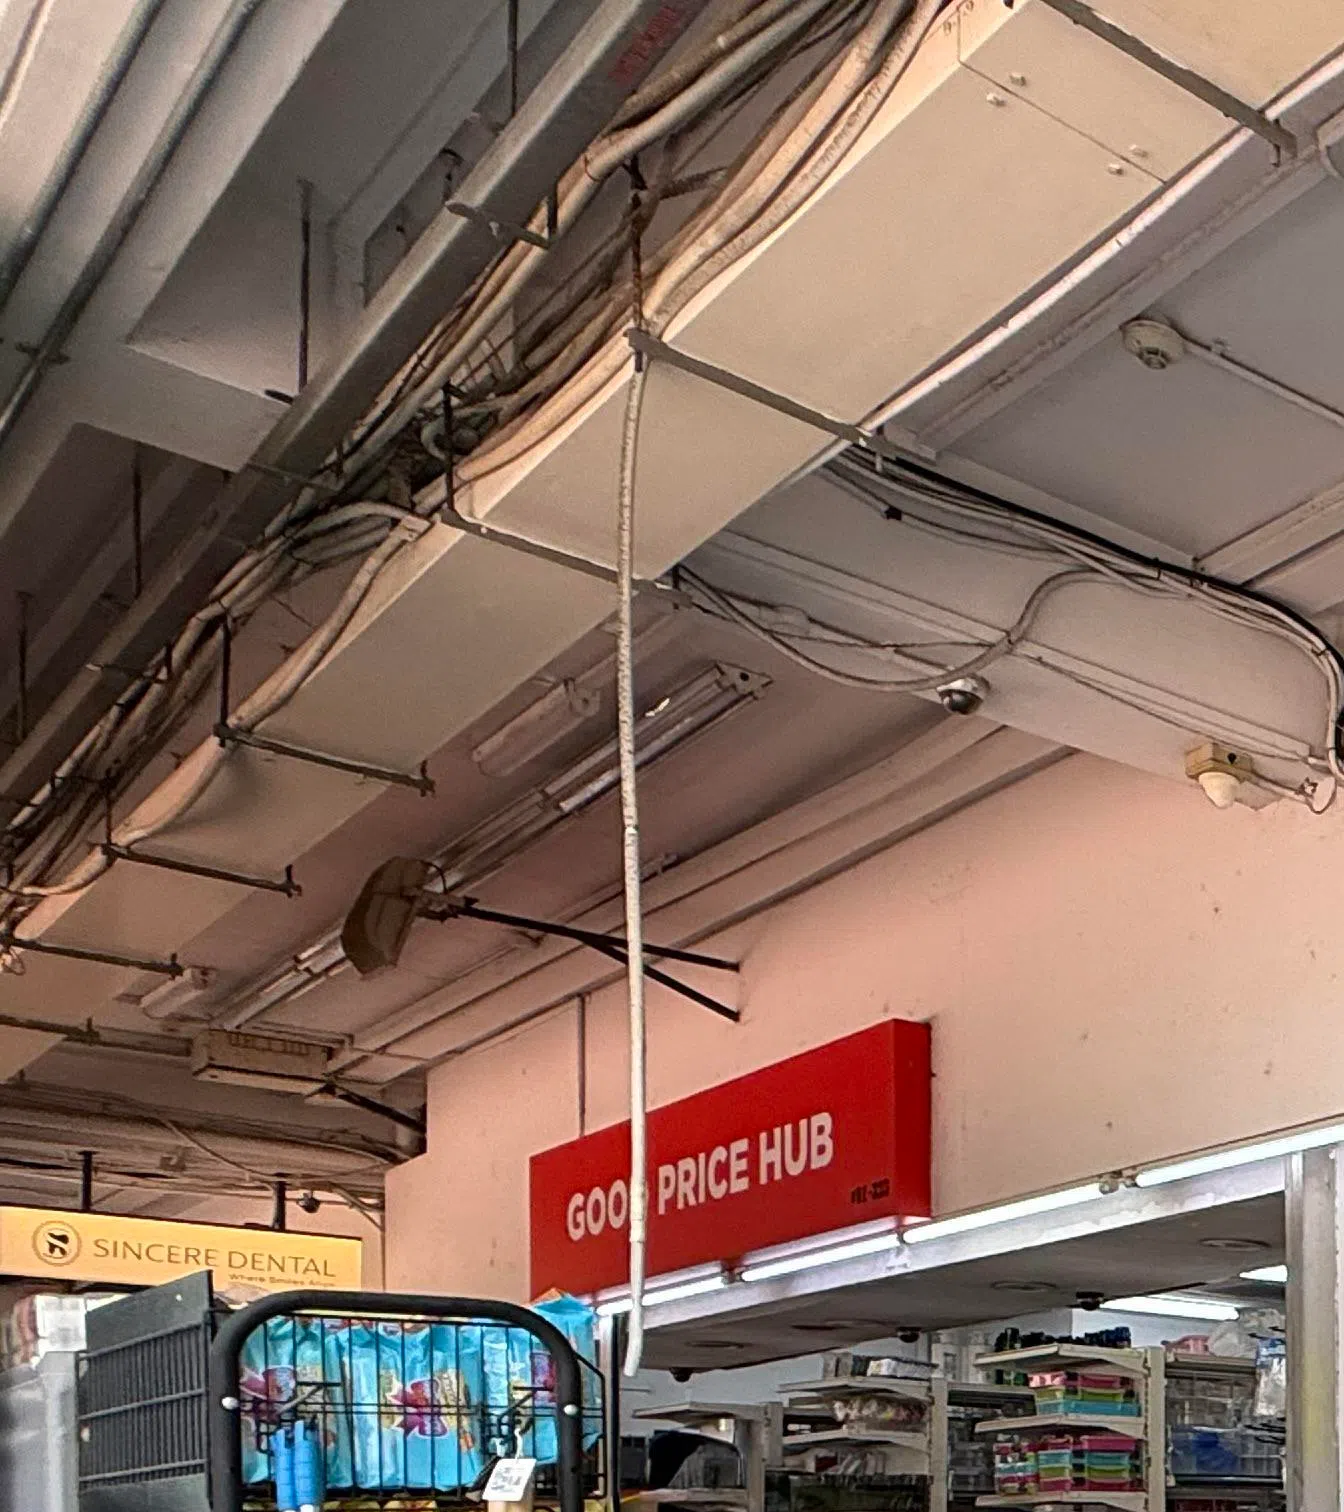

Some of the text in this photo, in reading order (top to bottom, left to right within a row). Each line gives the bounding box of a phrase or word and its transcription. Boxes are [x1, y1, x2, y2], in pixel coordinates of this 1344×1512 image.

[567, 1112, 834, 1241] GOO PRICE HUB
[93, 1238, 336, 1277] SINCERE DENTAL
